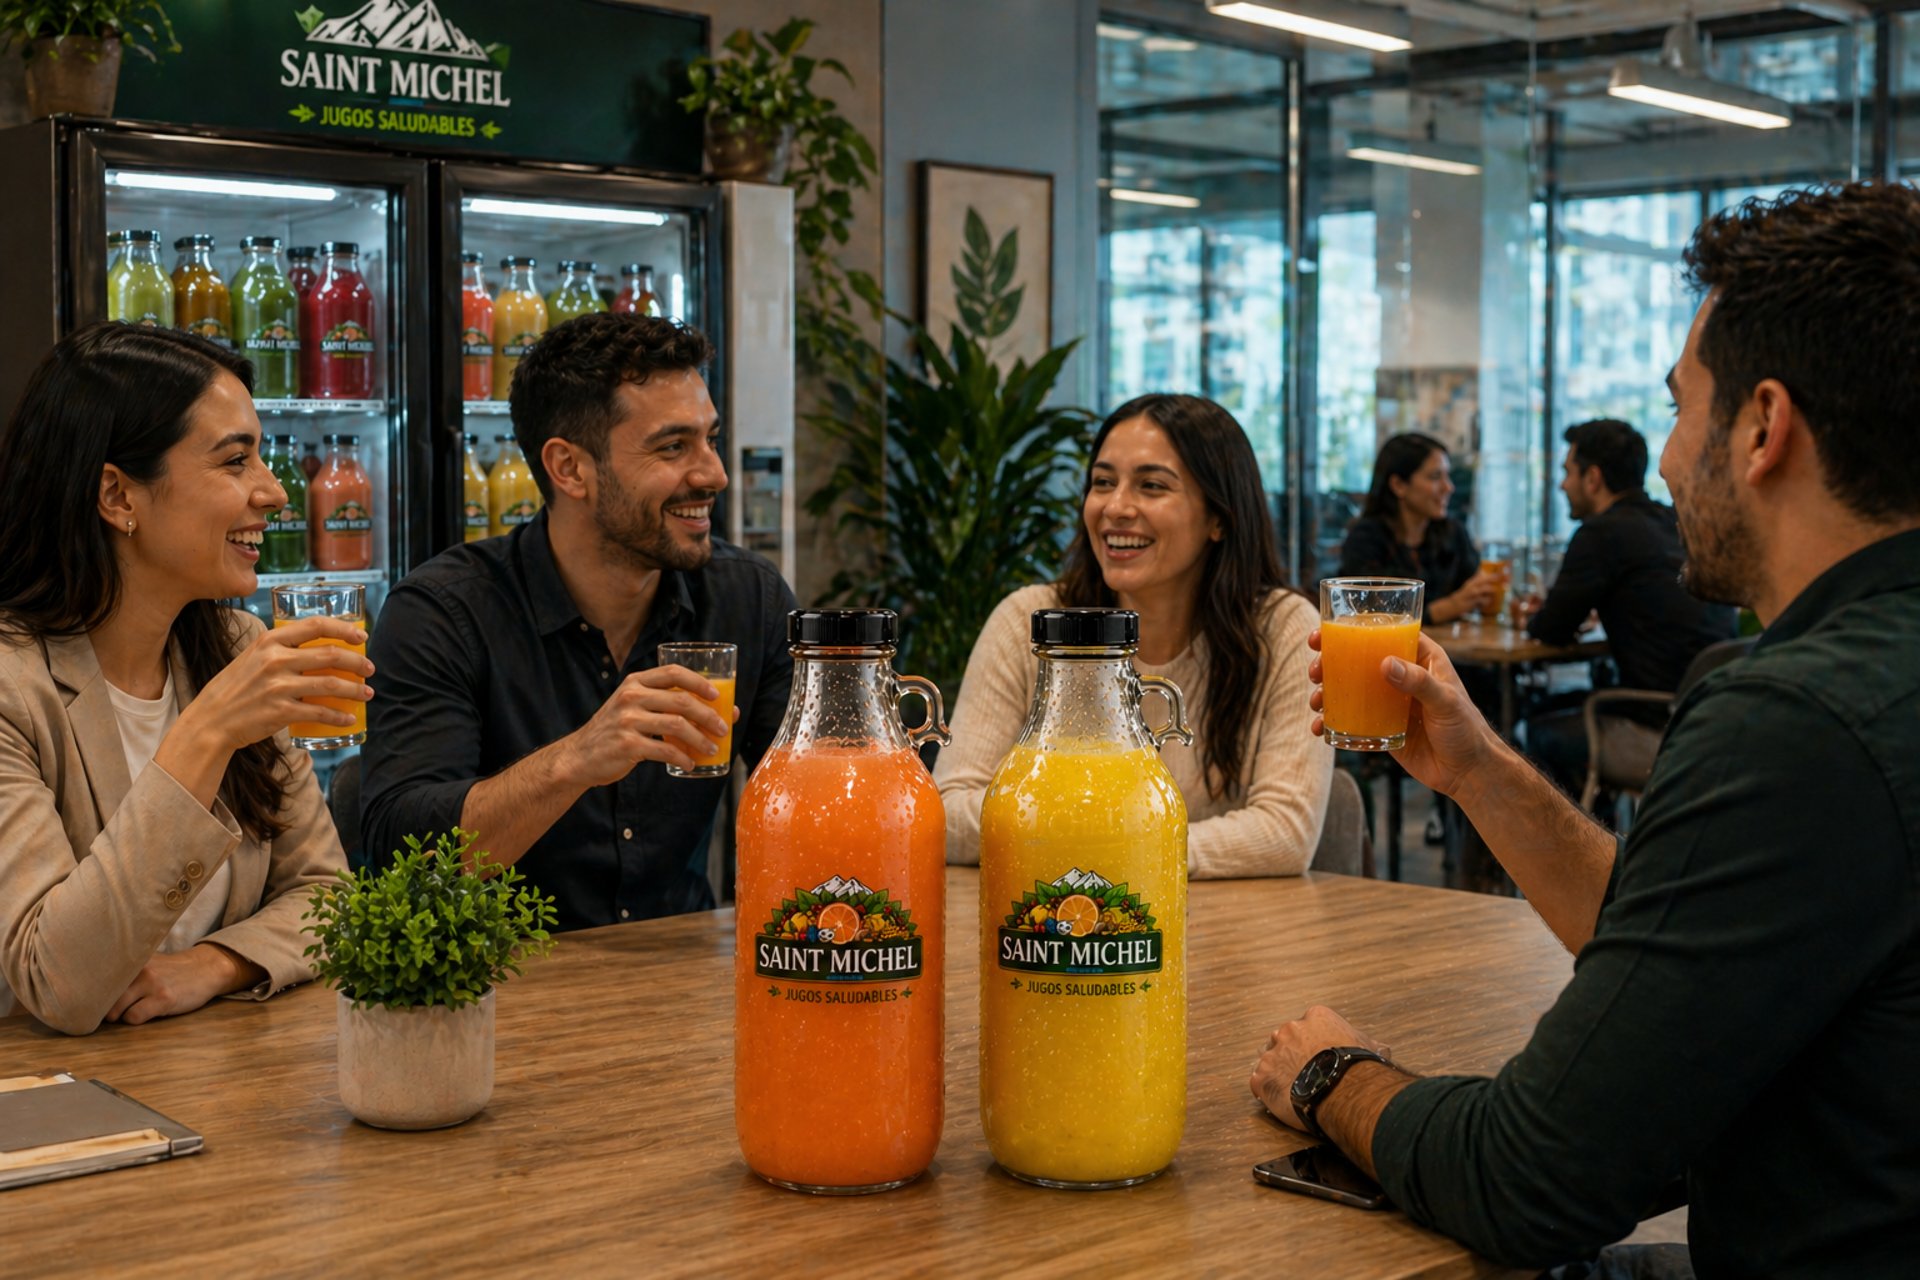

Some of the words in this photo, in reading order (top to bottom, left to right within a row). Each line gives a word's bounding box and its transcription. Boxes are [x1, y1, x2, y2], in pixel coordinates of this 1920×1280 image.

[280, 49, 382, 94] SAINT
[389, 60, 511, 107] MICHEL
[319, 105, 375, 128] JUGOS
[378, 110, 476, 137] SALUDABLES
[759, 943, 825, 972] SAINT
[830, 945, 918, 973] MICHEL
[1002, 936, 1064, 965] SAINT
[1070, 939, 1158, 966] MICHEL
[785, 988, 822, 1003] JUGOS
[826, 989, 898, 1004] SALUDABLES
[1026, 980, 1062, 995] JUGOS
[1065, 982, 1136, 996] SALUDABLES
